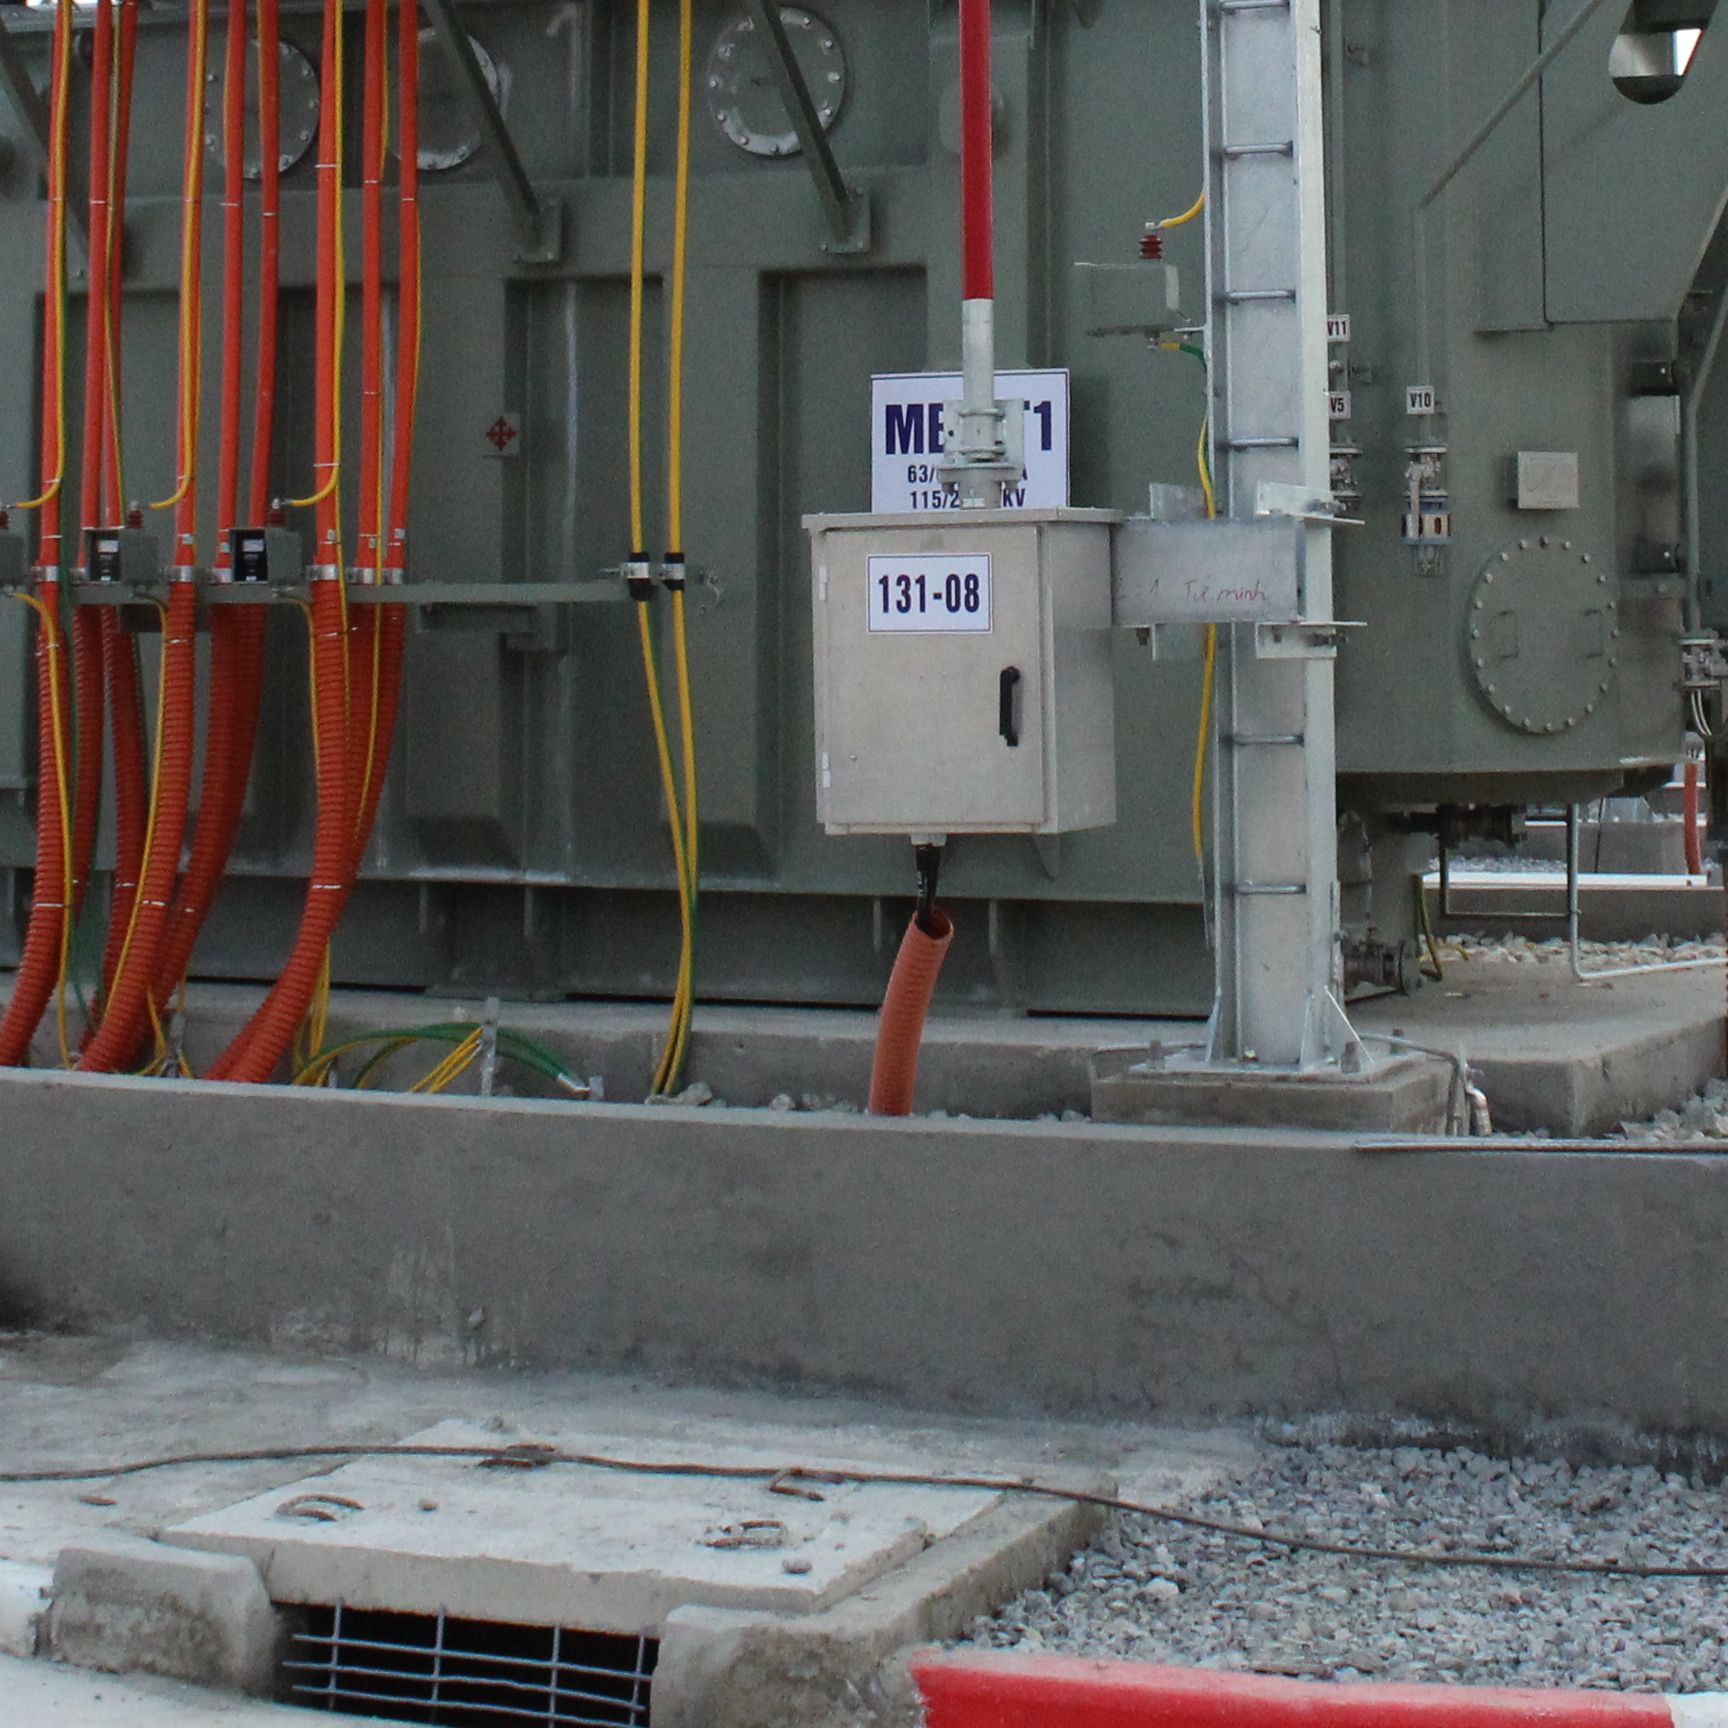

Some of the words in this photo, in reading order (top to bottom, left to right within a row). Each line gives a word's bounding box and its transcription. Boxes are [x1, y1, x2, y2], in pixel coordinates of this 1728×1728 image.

[1330, 397, 1344, 412] V5
[1410, 392, 1432, 408] V10
[878, 573, 980, 614] 131-08
